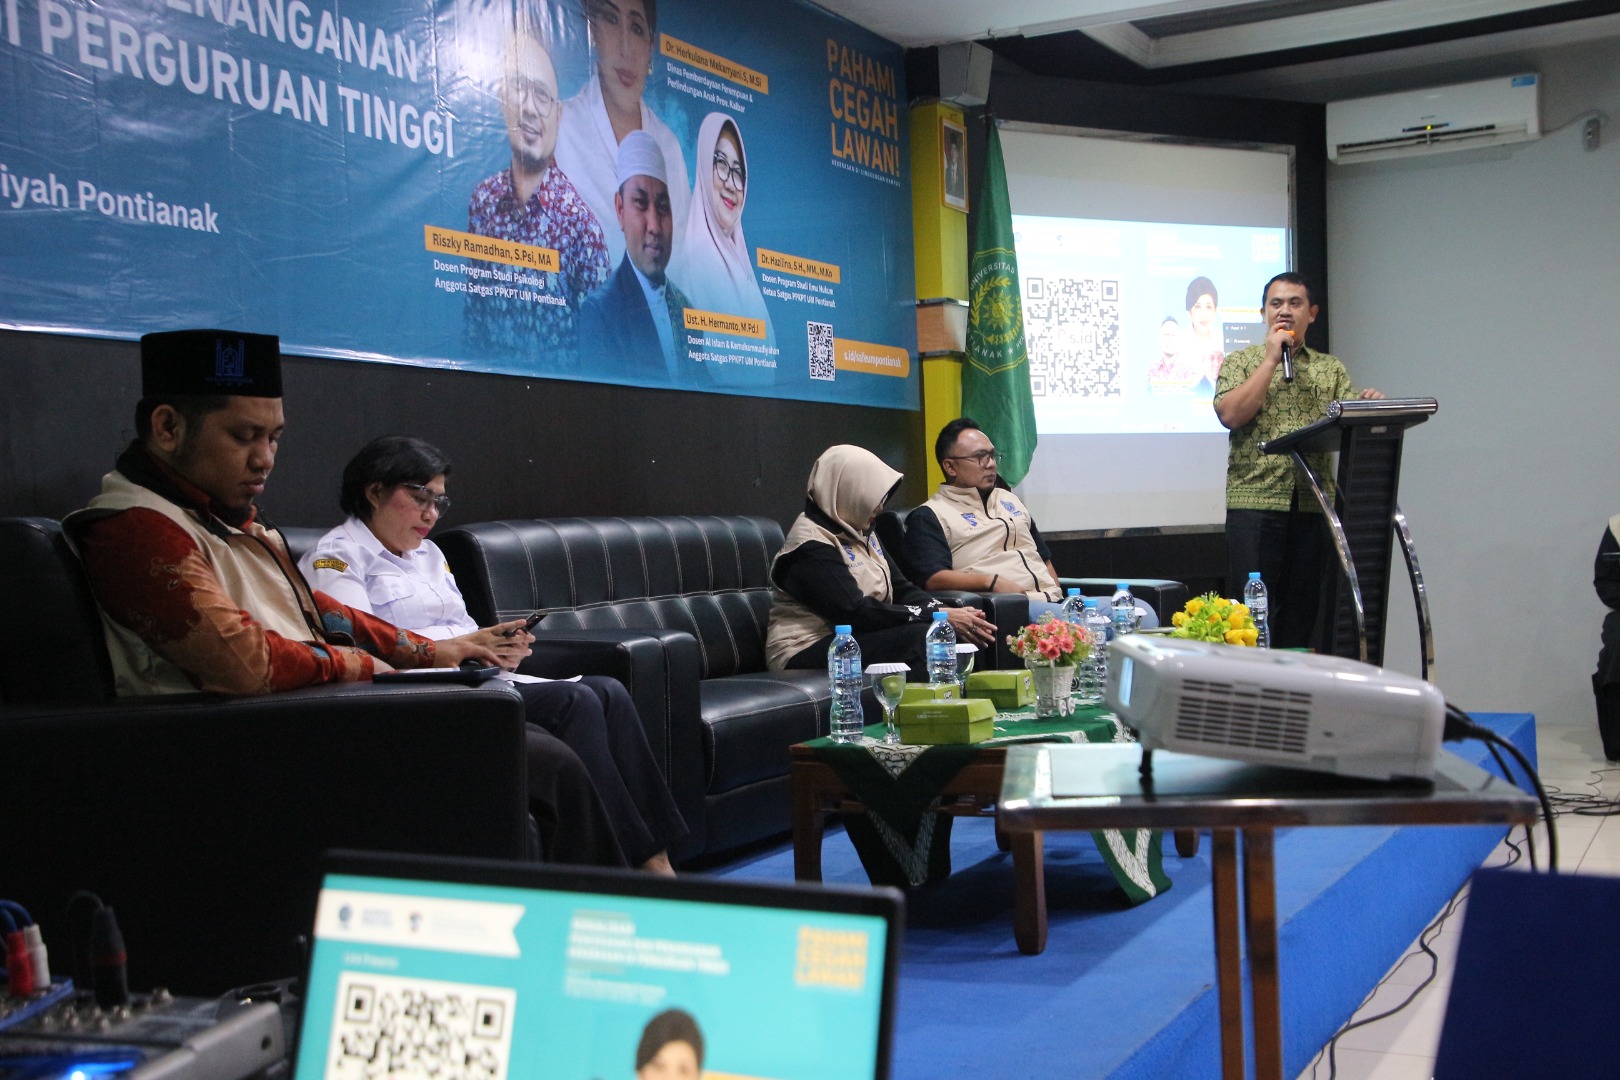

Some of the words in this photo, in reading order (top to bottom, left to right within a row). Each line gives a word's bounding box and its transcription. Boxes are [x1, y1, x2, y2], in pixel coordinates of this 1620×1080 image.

[166, 0, 418, 83] ANGANAN
[666, 41, 675, 54] Dr.
[677, 45, 709, 67] Herkulana
[0, 0, 21, 47] I
[38, 0, 328, 126] PERGURUAN
[339, 84, 454, 158] TINGGI
[667, 62, 682, 75] Dinas
[827, 38, 896, 99] PAHAMI
[667, 77, 702, 98] Perlindungan
[703, 90, 716, 103] Anak
[730, 100, 745, 113] Kalbar
[829, 78, 898, 140] CEGAH
[831, 122, 899, 177] LAWAN!
[78, 180, 220, 234] Pontianak
[433, 233, 461, 252] Riszky
[464, 239, 513, 261] Ramadhan,
[515, 248, 536, 266] S.Psi,
[538, 253, 552, 266] MA
[434, 259, 459, 273] Dosen
[461, 264, 492, 279] Program
[493, 270, 513, 282] Studi
[514, 273, 545, 289] Psikologi
[762, 273, 778, 285] Dosen
[778, 277, 797, 288] Program
[797, 280, 808, 290] Studi
[819, 285, 834, 295] Hukum
[435, 277, 467, 293] Anggota
[468, 283, 493, 297] Satgas
[495, 287, 518, 299] PPKPT
[520, 291, 531, 301] UM
[533, 292, 567, 306] Pontianak
[762, 286, 776, 297] Ketua
[777, 289, 792, 301] Satgas
[792, 292, 807, 303] PPKPT
[807, 295, 815, 304] UM
[815, 297, 836, 308] Pontianak
[686, 314, 699, 326] Ust.
[701, 316, 708, 327] H.
[708, 317, 741, 334] Hermanto,
[1070, 330, 1092, 344] s.id
[687, 335, 705, 345] Dosen
[711, 338, 725, 348] Islam
[688, 350, 710, 362] Anggota
[710, 352, 728, 364] Satgas
[728, 355, 745, 365] PPKPT
[745, 357, 753, 366] UM
[754, 358, 777, 368] Pontianak
